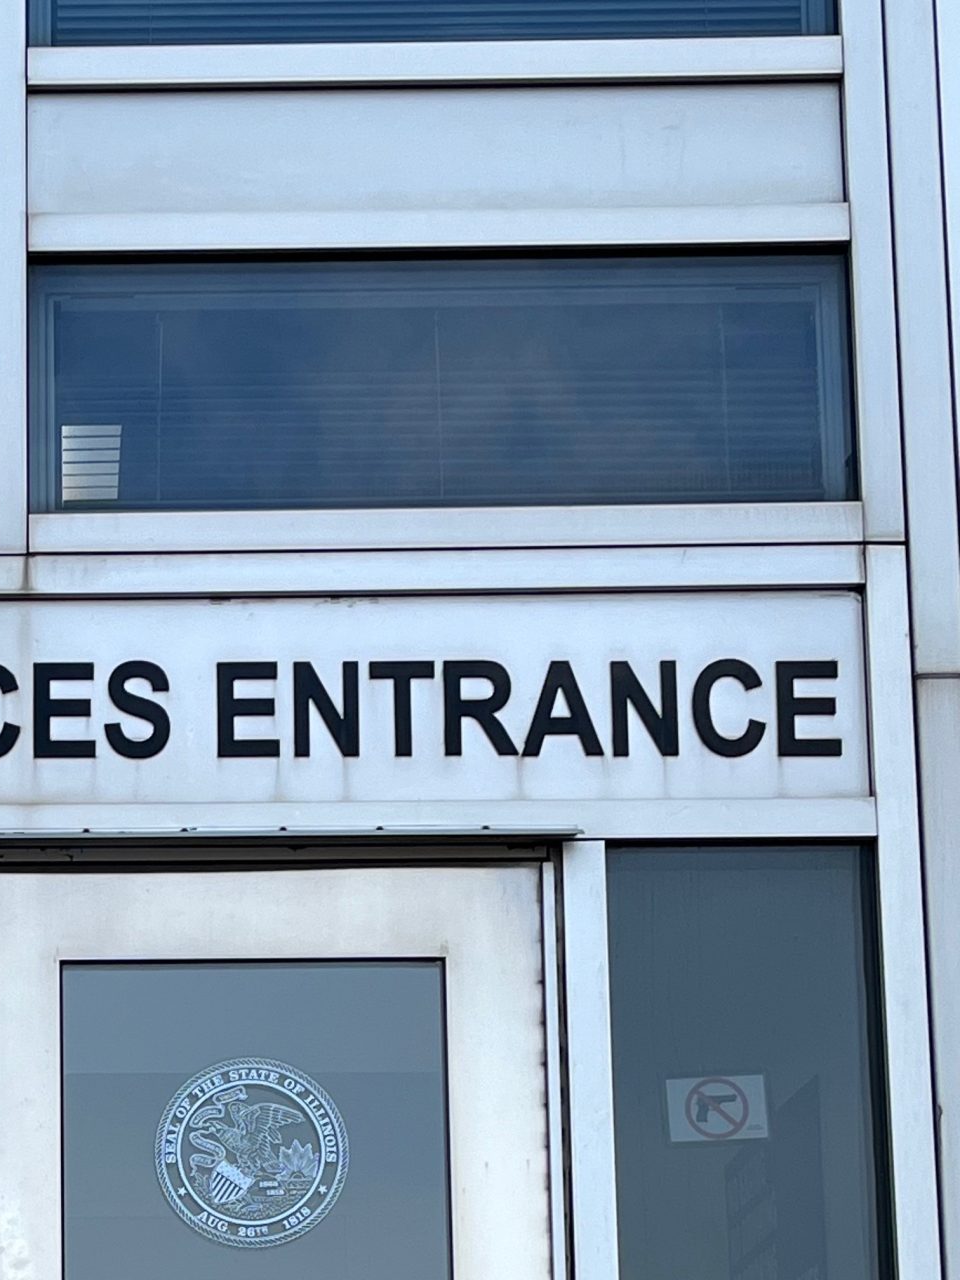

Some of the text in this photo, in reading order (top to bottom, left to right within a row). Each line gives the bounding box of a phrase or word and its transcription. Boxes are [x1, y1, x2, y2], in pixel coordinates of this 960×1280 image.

[216, 659, 843, 758] ENTRANCE
[165, 1123, 180, 1164] SEAL
[175, 1097, 191, 1119] OF
[191, 1074, 224, 1098] THE
[229, 1069, 280, 1084] STATE
[283, 1078, 305, 1095] OF
[304, 1094, 337, 1163] ILLINOIS
[282, 1206, 311, 1230] 1818
